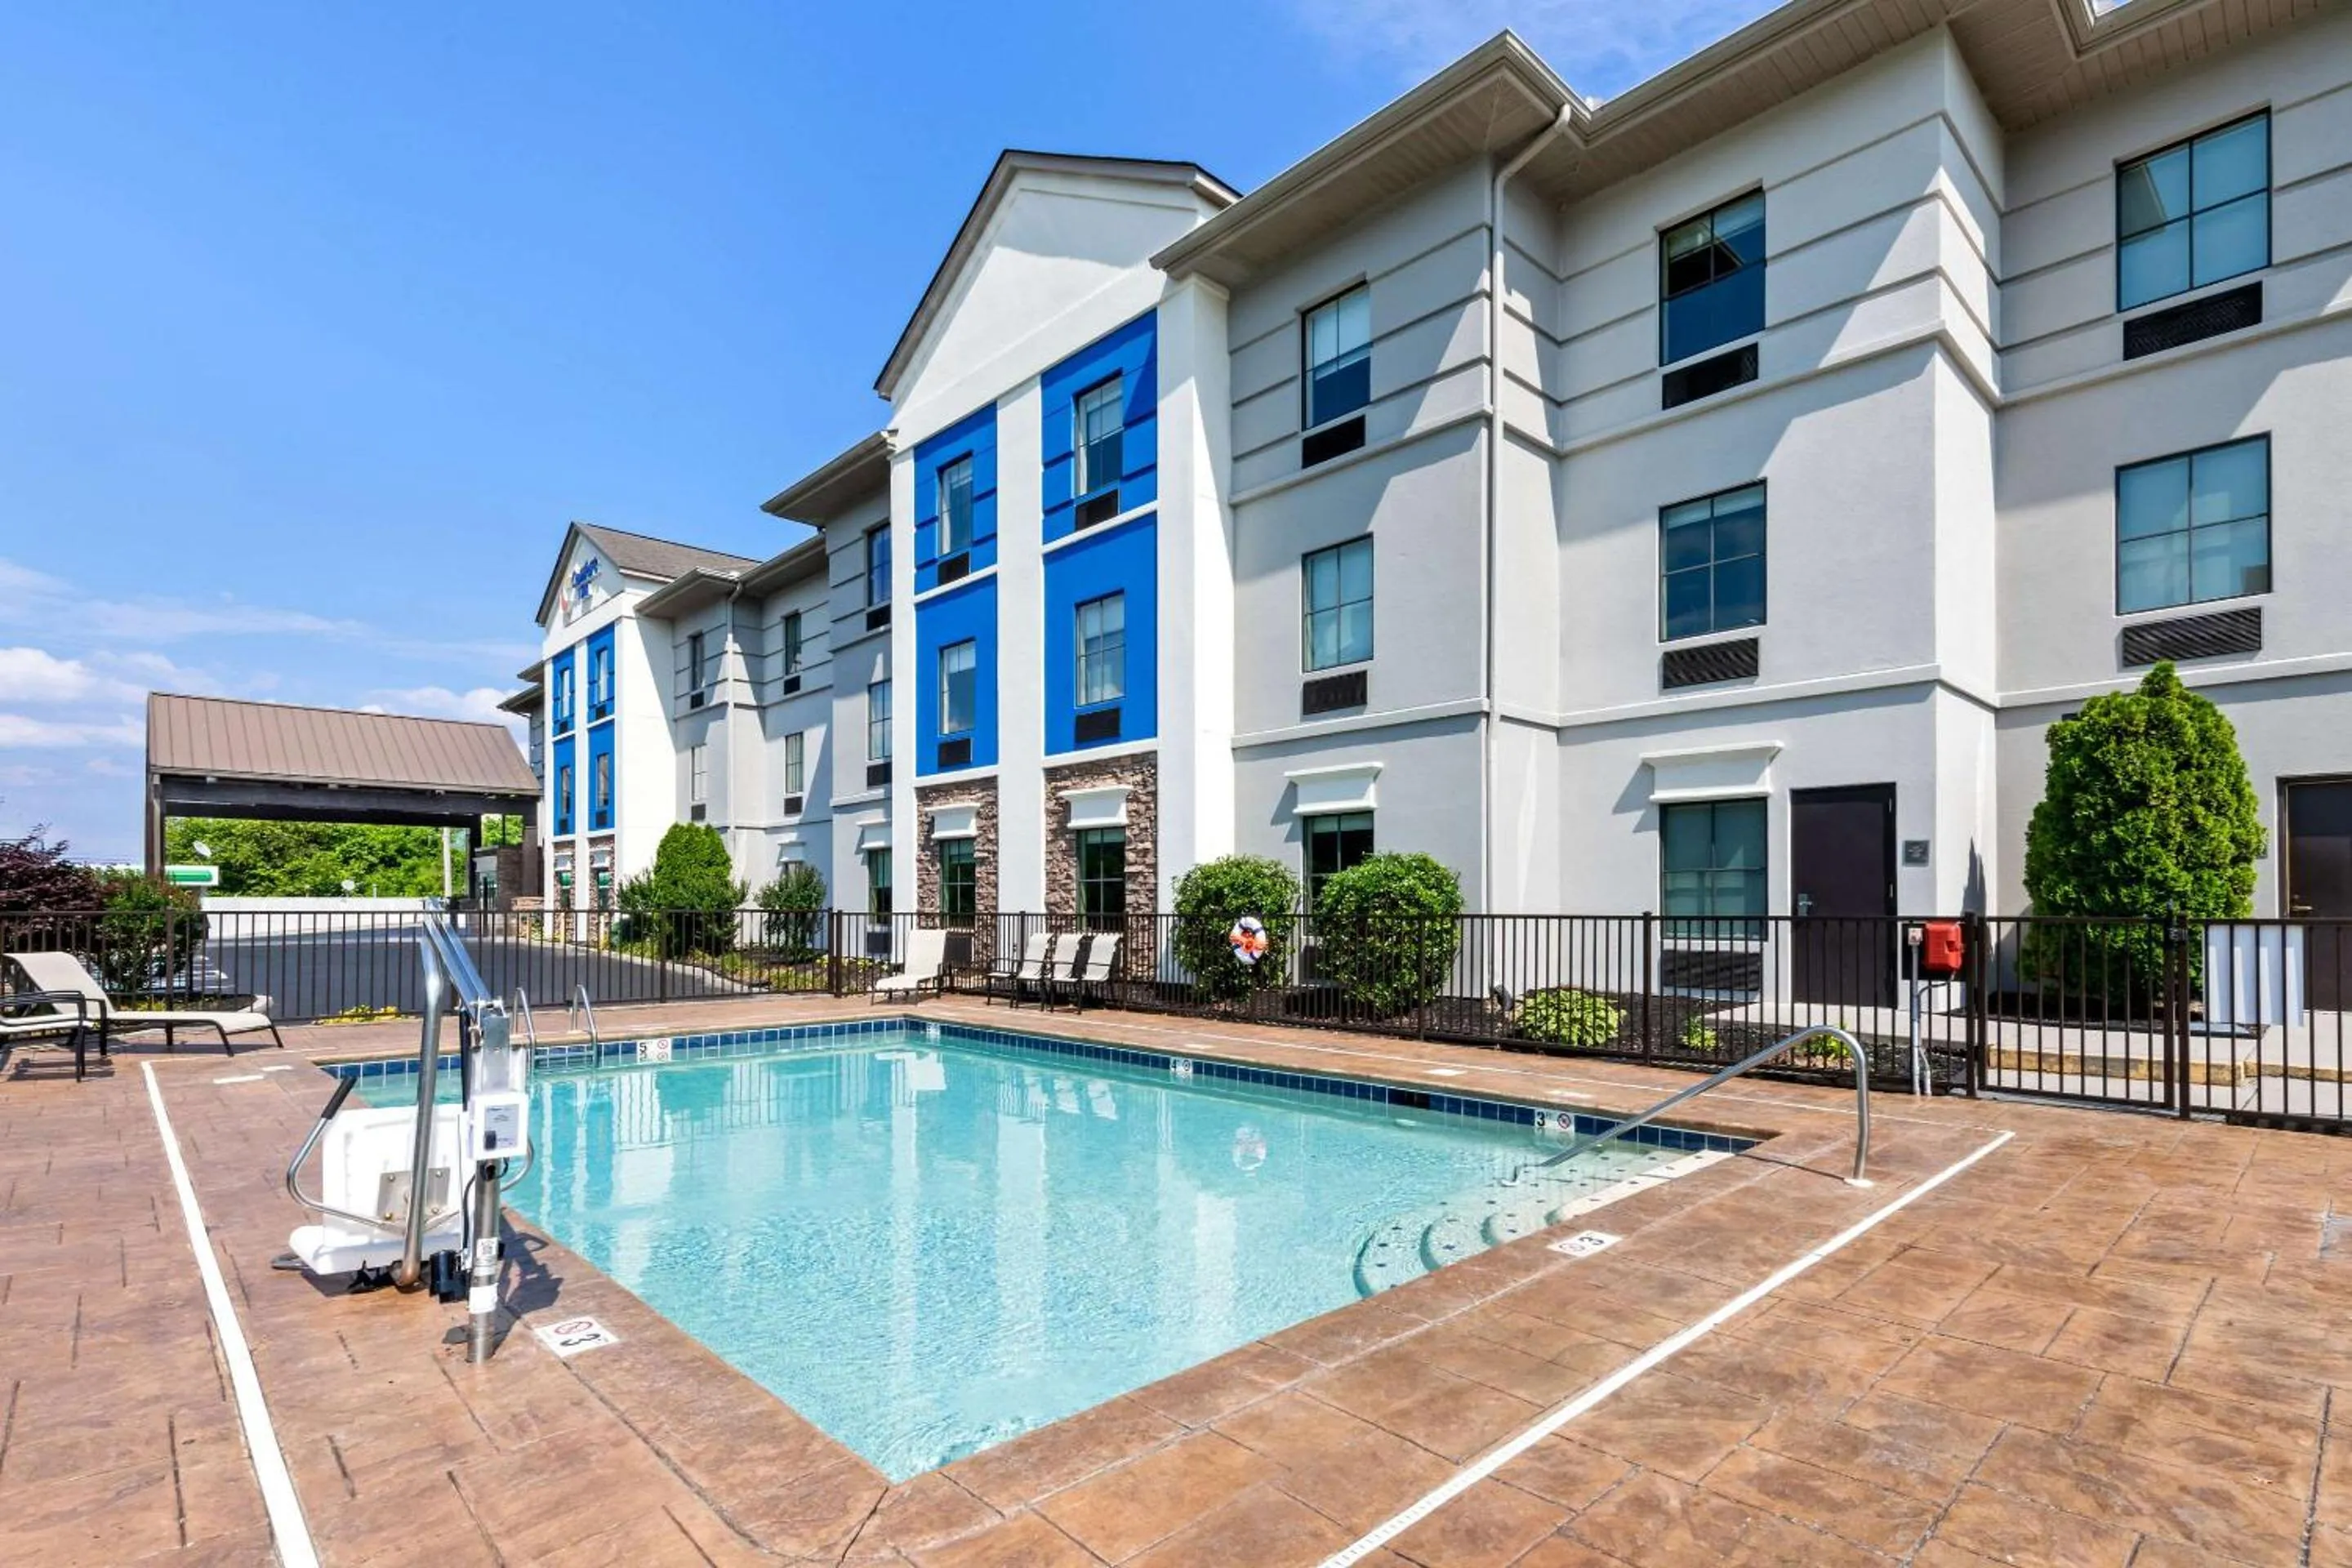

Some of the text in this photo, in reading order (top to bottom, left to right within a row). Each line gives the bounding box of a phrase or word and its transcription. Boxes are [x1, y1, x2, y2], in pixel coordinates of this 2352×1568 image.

[1537, 1111, 1545, 1126] 3
[1579, 1237, 1605, 1245] 3
[560, 1334, 601, 1346] 3
